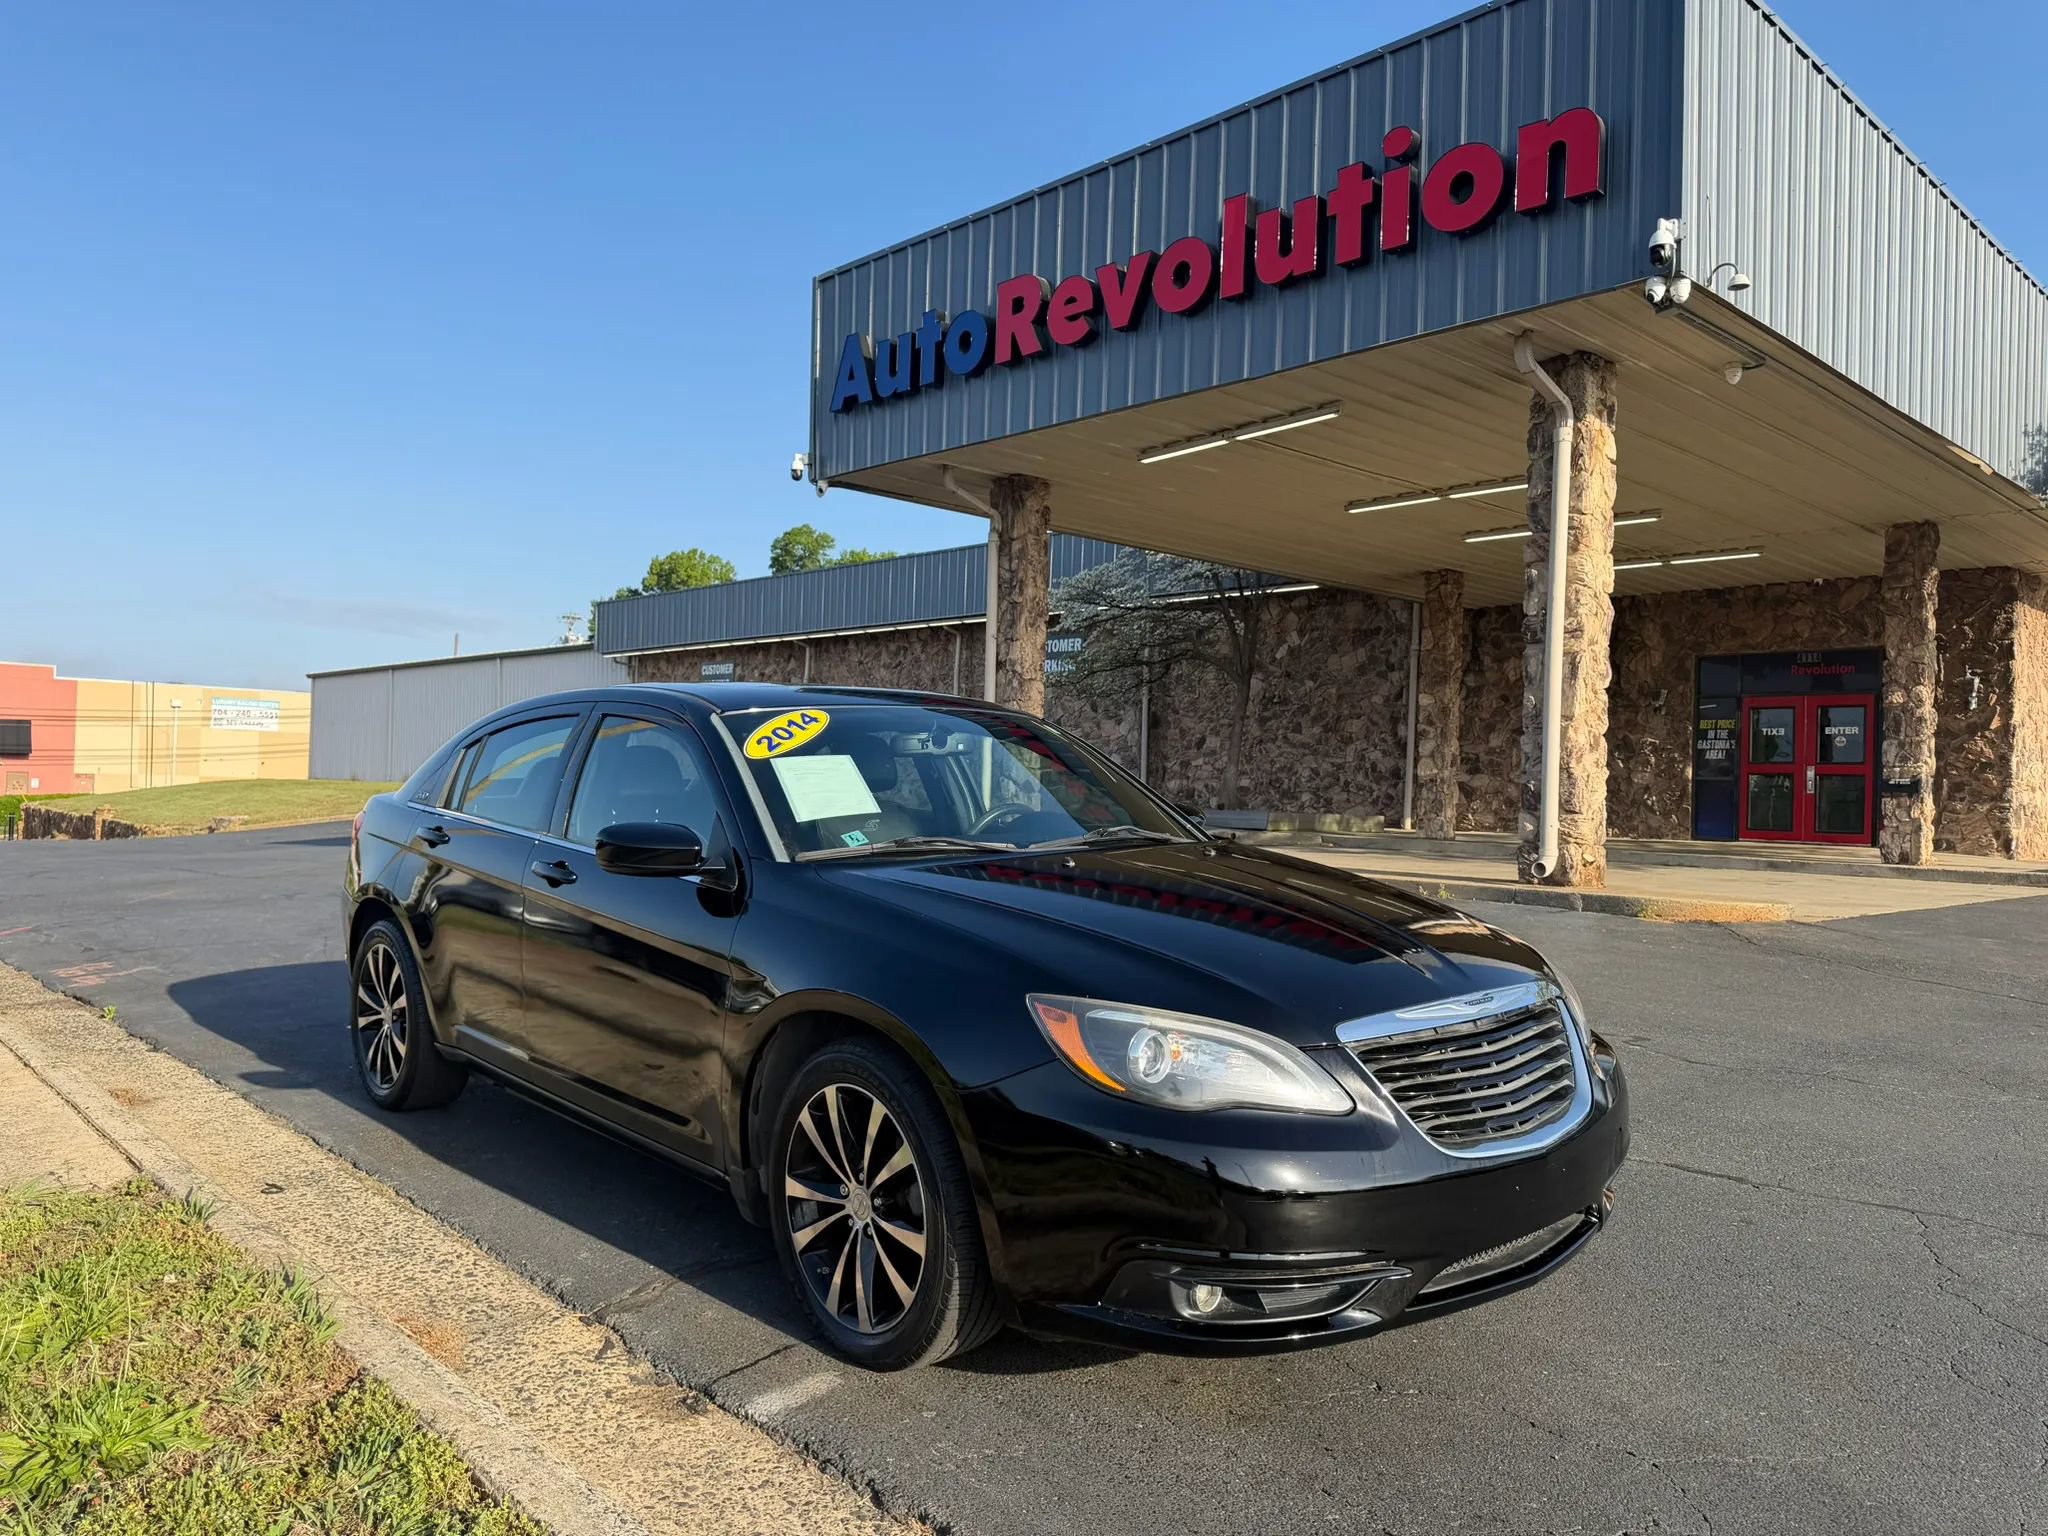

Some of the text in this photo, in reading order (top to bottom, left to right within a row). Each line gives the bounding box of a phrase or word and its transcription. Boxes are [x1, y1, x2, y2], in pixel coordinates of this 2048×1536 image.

[1046, 638, 1082, 653] TOMER
[1699, 719, 1736, 729] BEST PRICE
[756, 712, 820, 753] 2014
[1707, 729, 1729, 739] IN THE
[1825, 726, 1859, 735] ENTER
